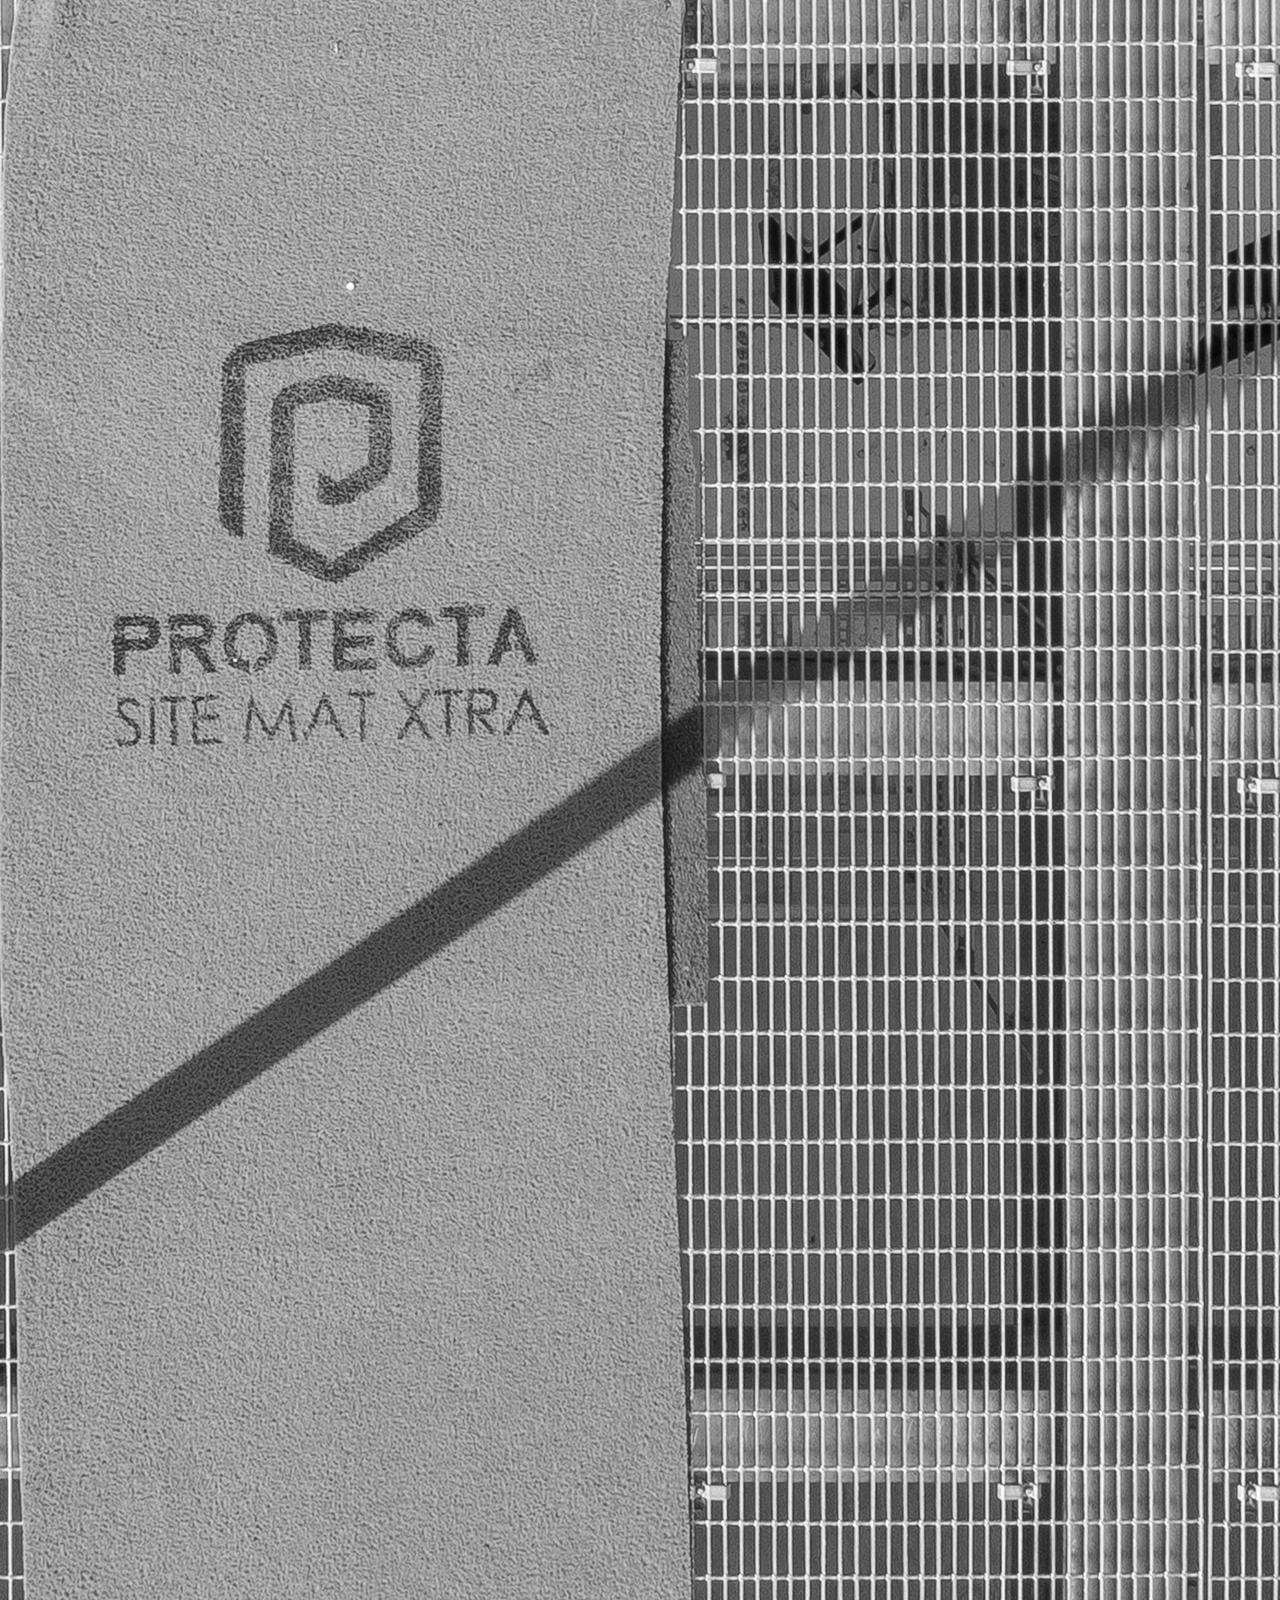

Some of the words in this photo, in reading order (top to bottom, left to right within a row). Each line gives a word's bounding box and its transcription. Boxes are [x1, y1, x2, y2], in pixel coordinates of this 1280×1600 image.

[112, 605, 538, 675] PROTECTA
[115, 693, 221, 747] SITE
[243, 690, 375, 742] MAT
[397, 687, 551, 739] XTRA
